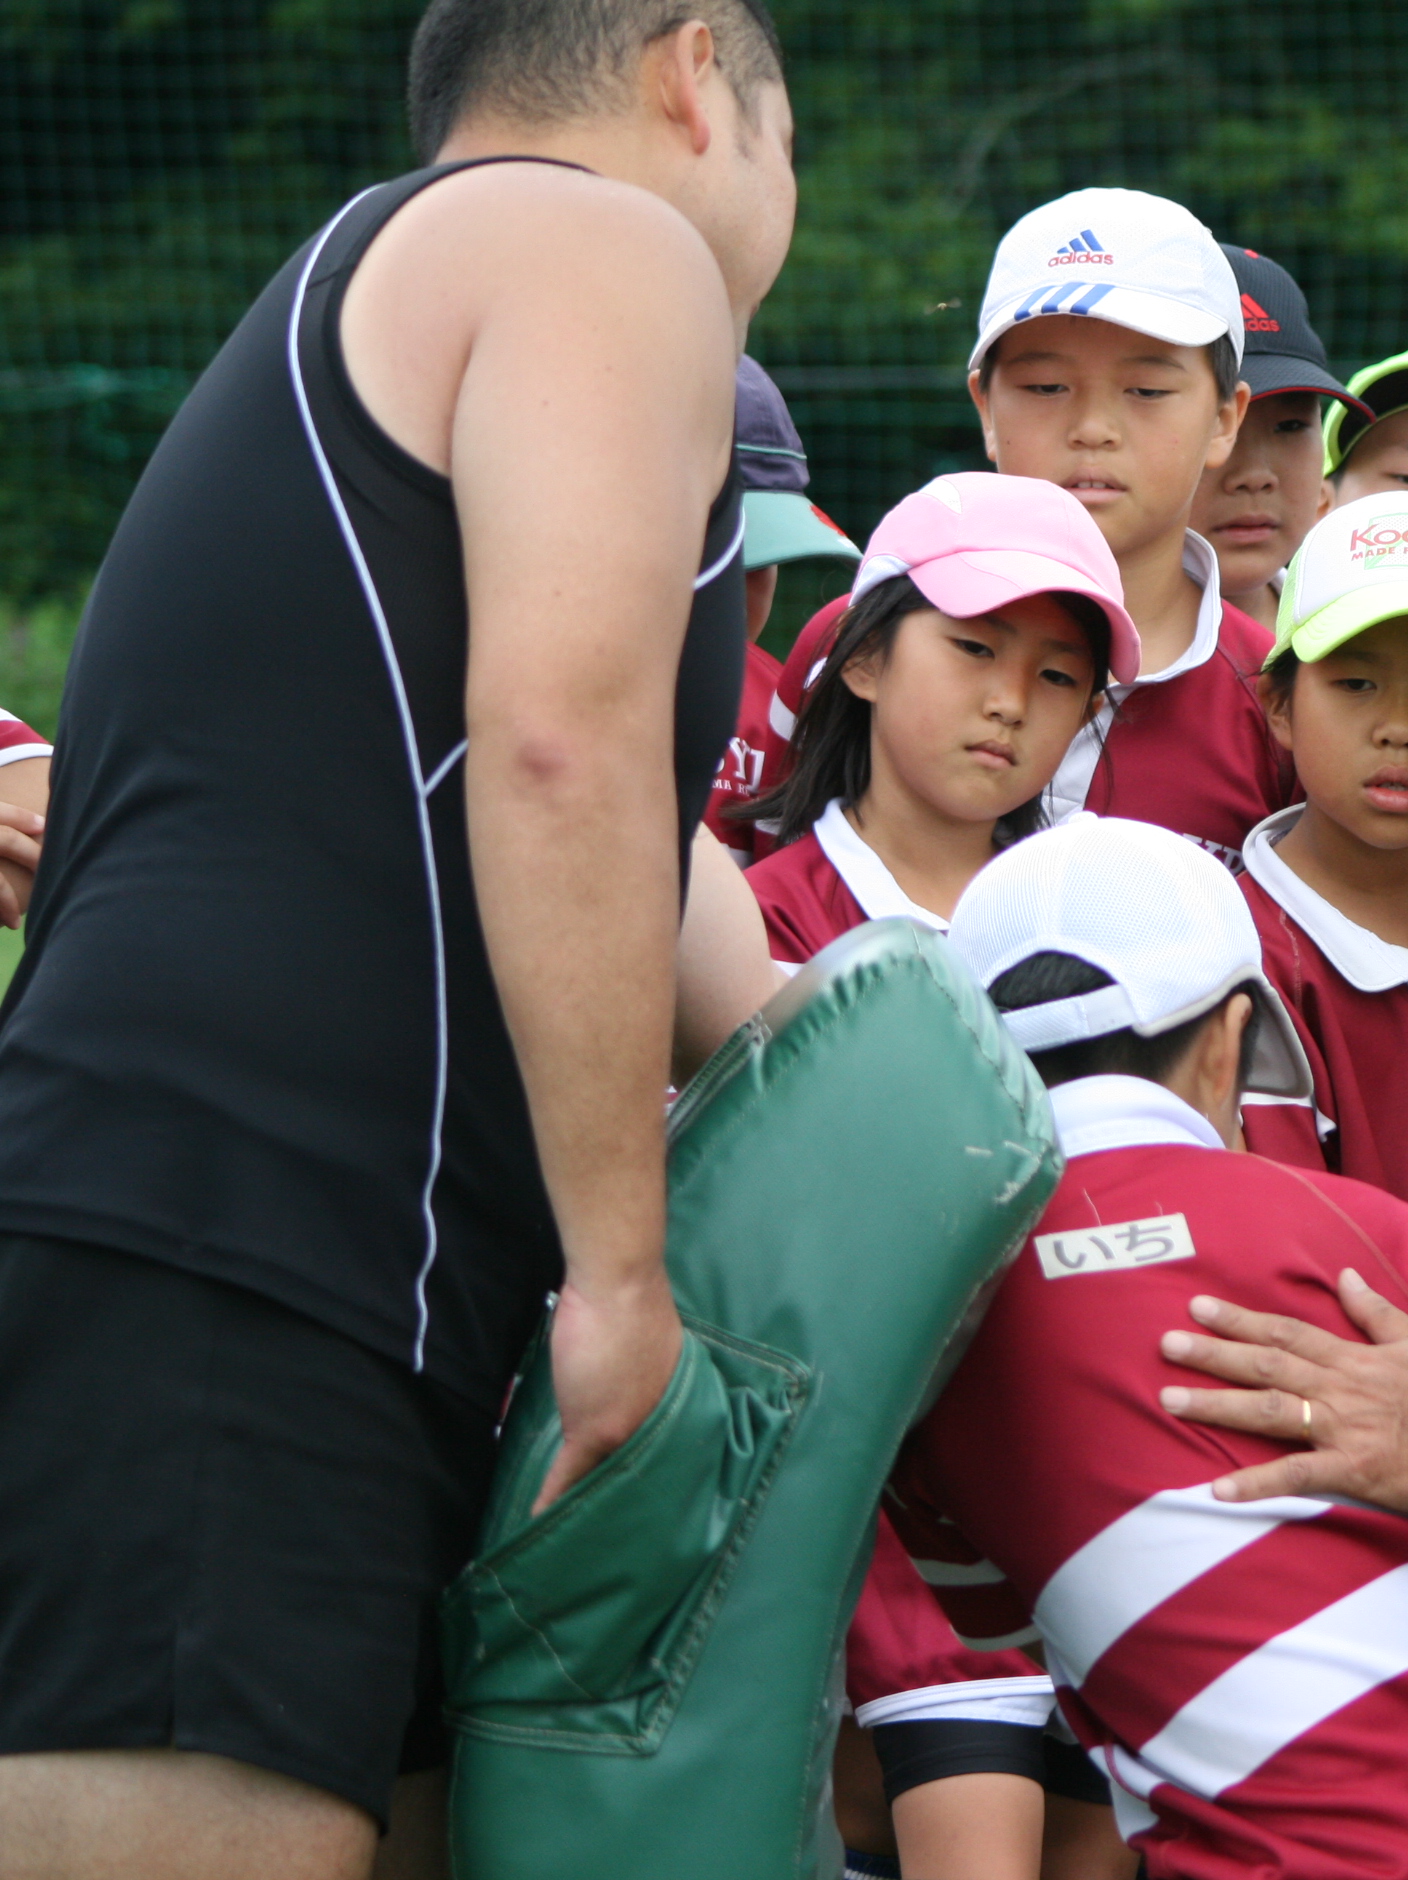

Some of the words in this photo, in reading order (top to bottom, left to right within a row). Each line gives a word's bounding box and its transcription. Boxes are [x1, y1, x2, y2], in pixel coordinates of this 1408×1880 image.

[1047, 251, 1114, 267] adidas
[1351, 546, 1396, 562] MADE
[1053, 1224, 1175, 1269] いち
